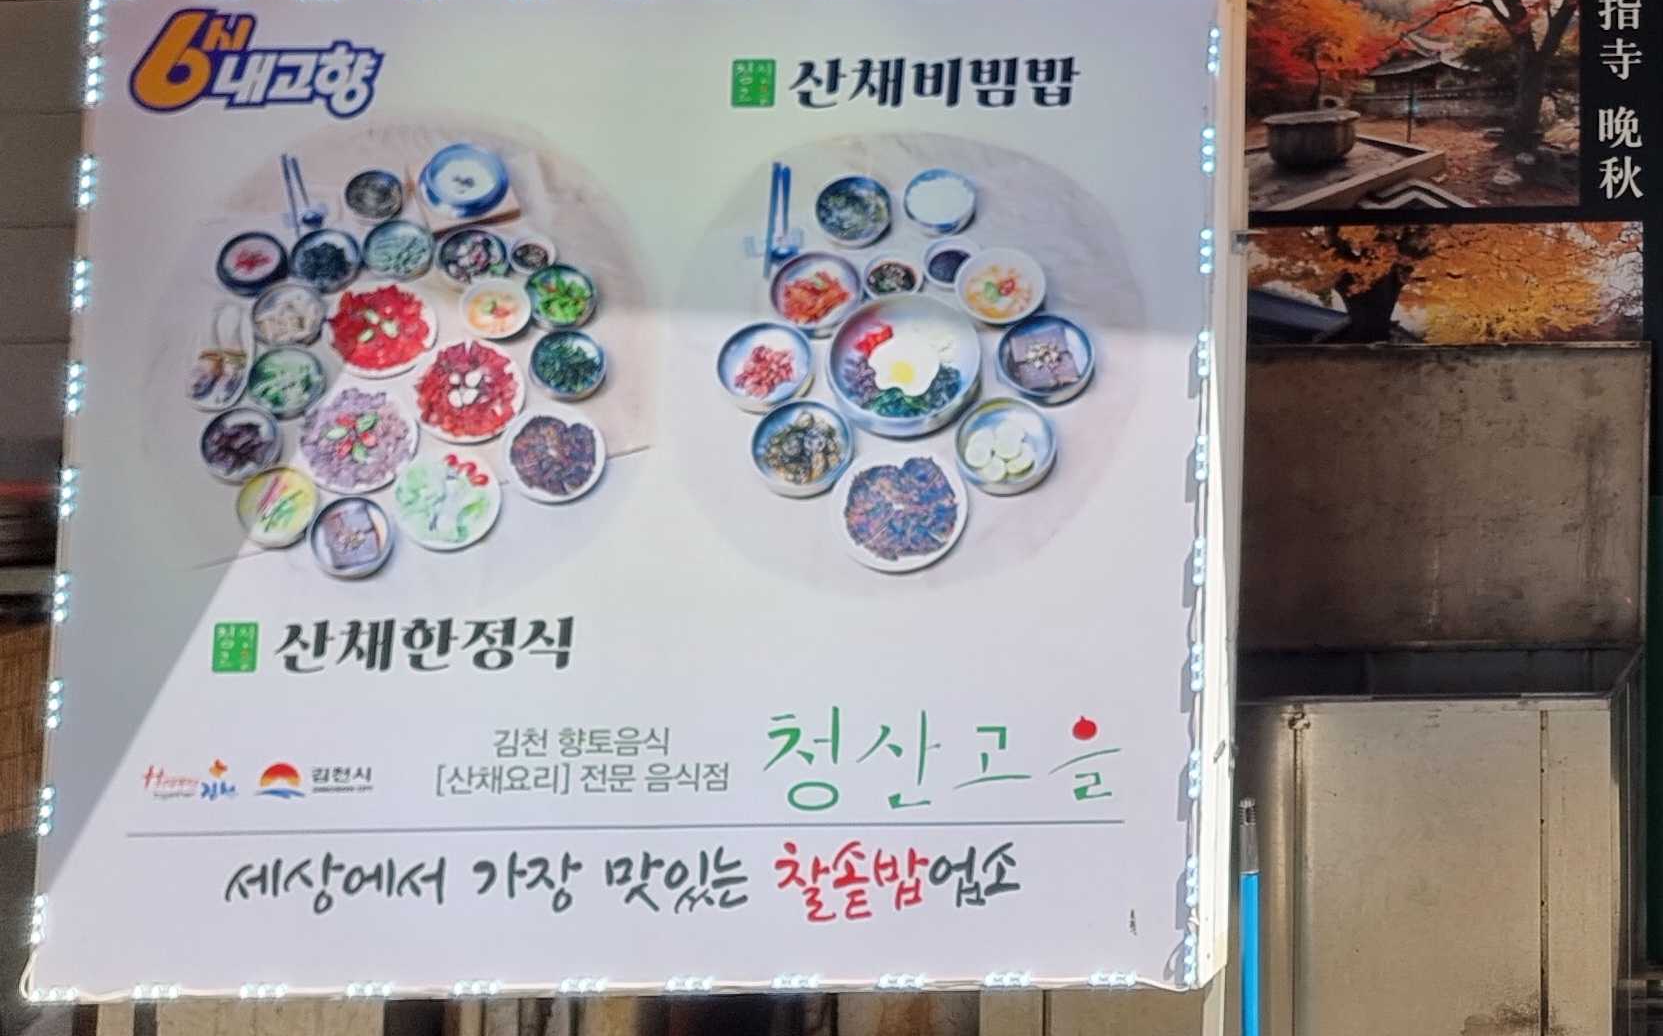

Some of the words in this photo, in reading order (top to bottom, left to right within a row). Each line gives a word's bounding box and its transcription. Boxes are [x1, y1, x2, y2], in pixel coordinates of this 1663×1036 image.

[130, 8, 257, 114] 6시
[209, 40, 384, 119] 내고향
[788, 56, 1081, 109] 산채비빔밥
[274, 615, 575, 673] 산채한정식
[493, 728, 548, 758] 김천
[558, 727, 671, 757] 향토음식
[764, 706, 1121, 811] 청산고을
[311, 766, 372, 783] 김천시
[436, 764, 571, 796] [산채요리]
[580, 763, 636, 794] 전문
[645, 762, 730, 793] 음식점
[224, 852, 446, 915] 세상에서
[473, 851, 582, 912] 가장
[605, 846, 749, 915] 맛있는
[774, 840, 1021, 922] 찰솥밥업소
